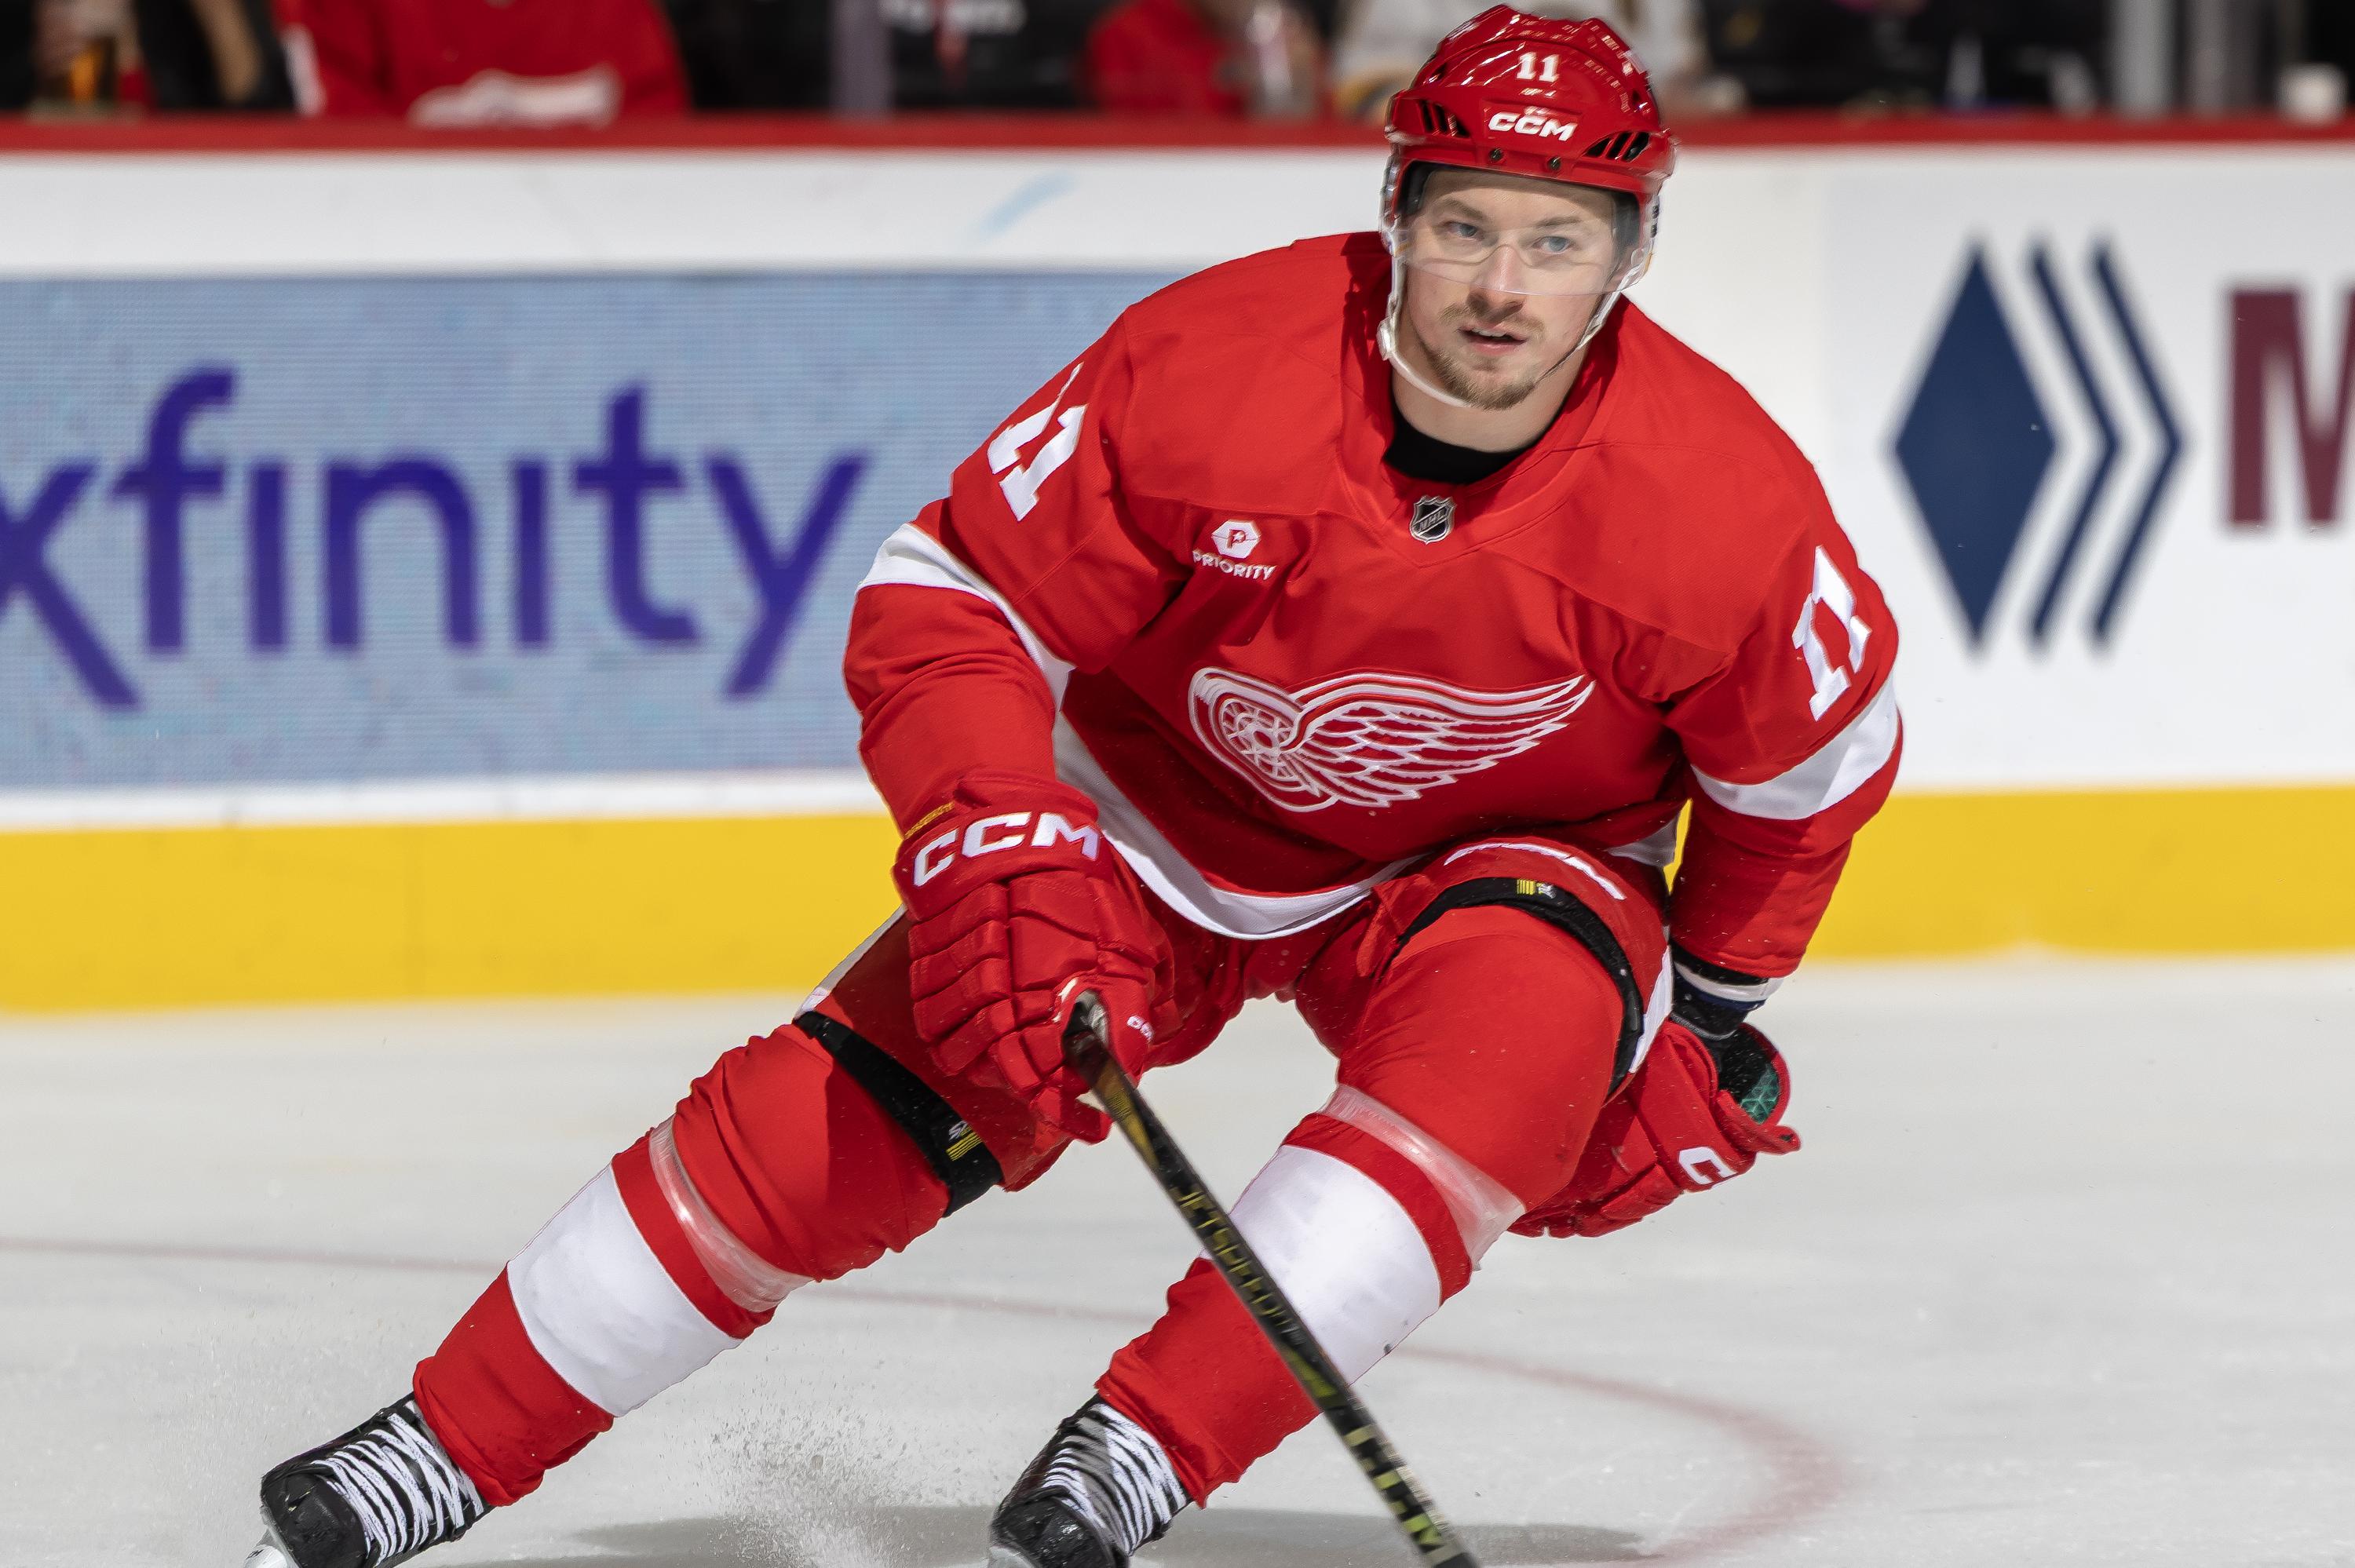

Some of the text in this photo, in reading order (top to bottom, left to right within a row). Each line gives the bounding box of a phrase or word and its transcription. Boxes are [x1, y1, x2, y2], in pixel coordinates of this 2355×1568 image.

[1516, 52, 1560, 82] 11
[1488, 111, 1578, 141] CCM
[987, 361, 1089, 522] 11
[1192, 549, 1276, 581] PRIORITY
[1791, 545, 1873, 722] 11
[914, 811, 1101, 888] CCM
[1176, 1190, 1284, 1317] JETSPEED
